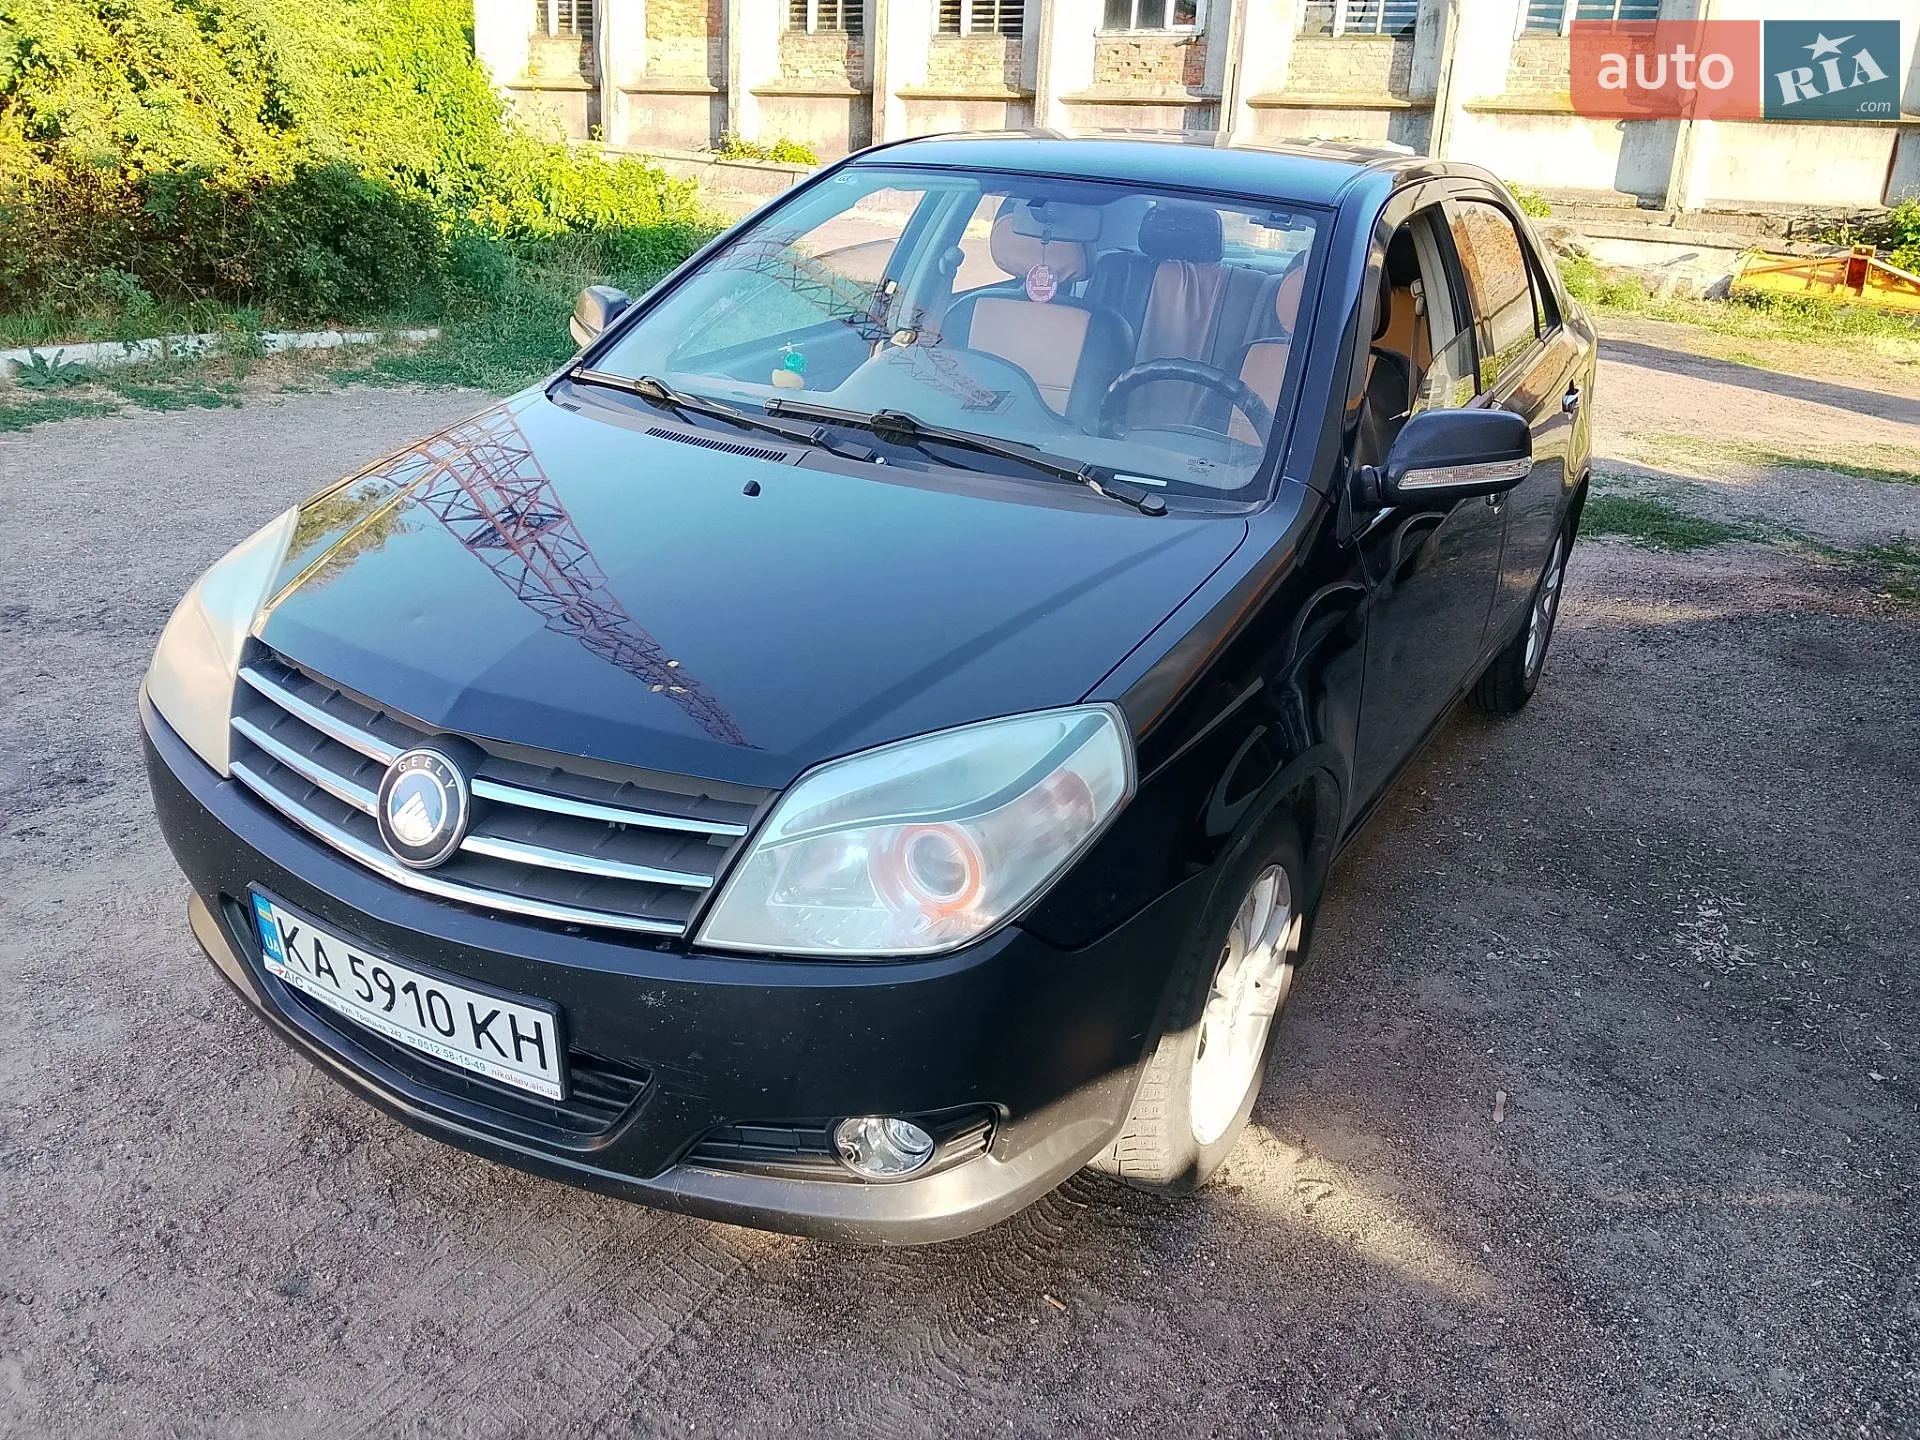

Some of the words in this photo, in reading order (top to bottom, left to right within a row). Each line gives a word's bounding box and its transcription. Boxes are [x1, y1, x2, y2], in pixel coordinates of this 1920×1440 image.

[398, 757, 456, 789] GEELY
[264, 936, 282, 957] UA
[276, 916, 341, 989] KA
[347, 954, 457, 1039] 5910
[466, 1001, 548, 1071] KH
